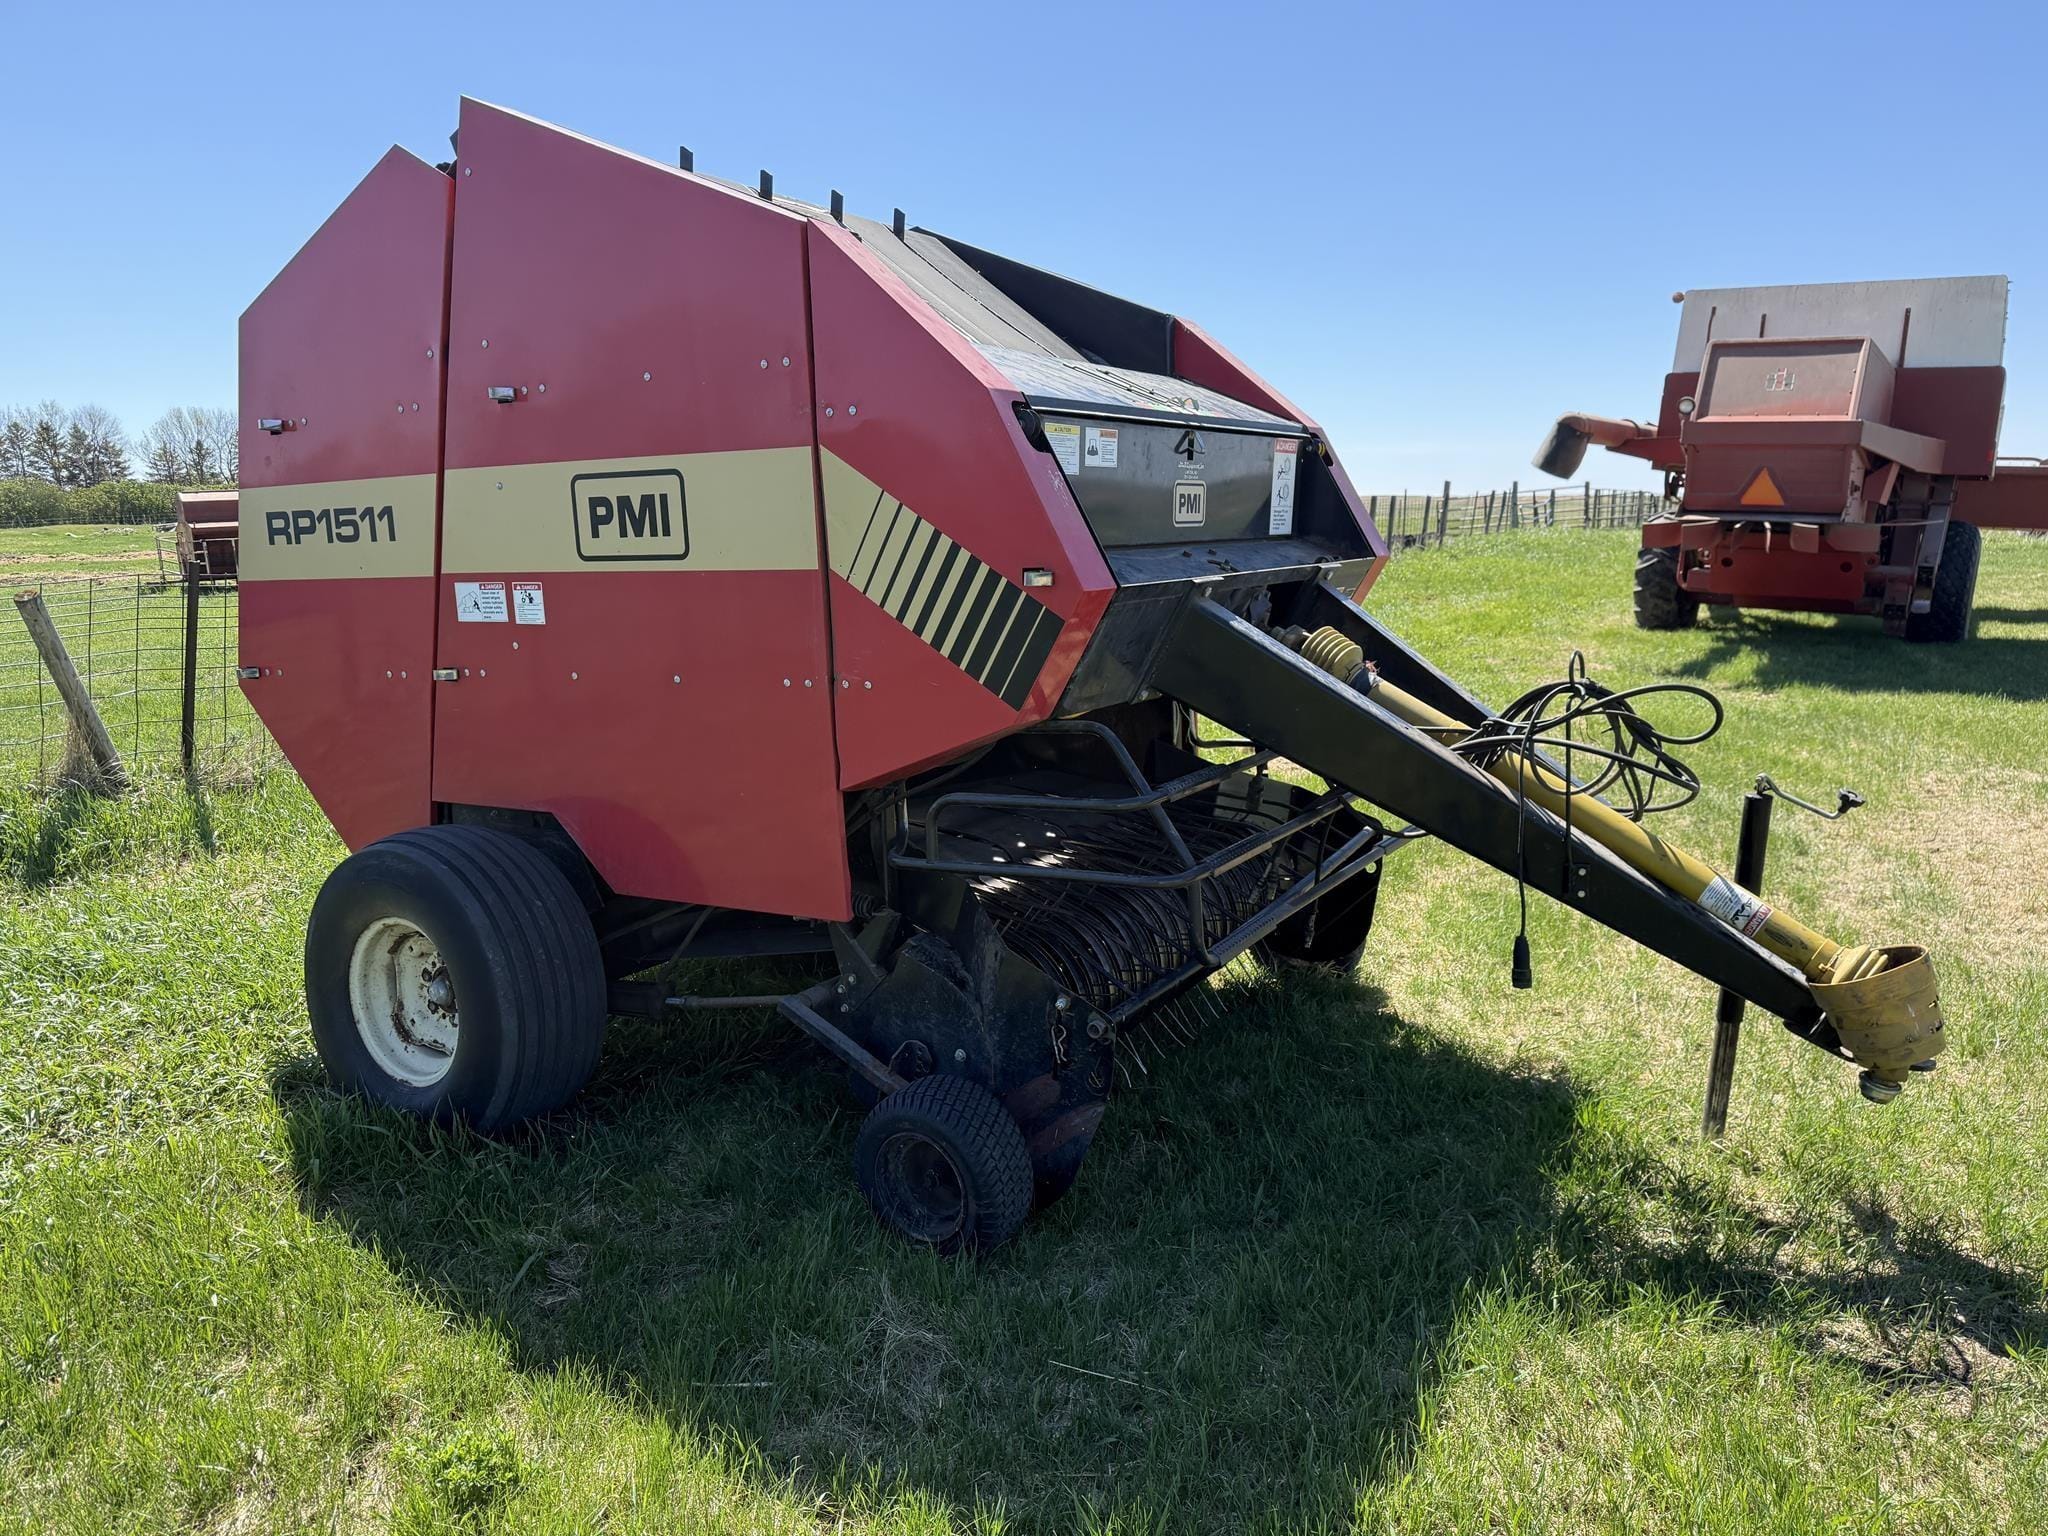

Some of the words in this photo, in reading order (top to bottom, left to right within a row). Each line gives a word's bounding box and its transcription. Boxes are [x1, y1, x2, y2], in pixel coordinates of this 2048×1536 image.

[588, 493, 671, 538] PMI
[1178, 493, 1201, 514] PMI
[266, 506, 396, 545] RP1511
